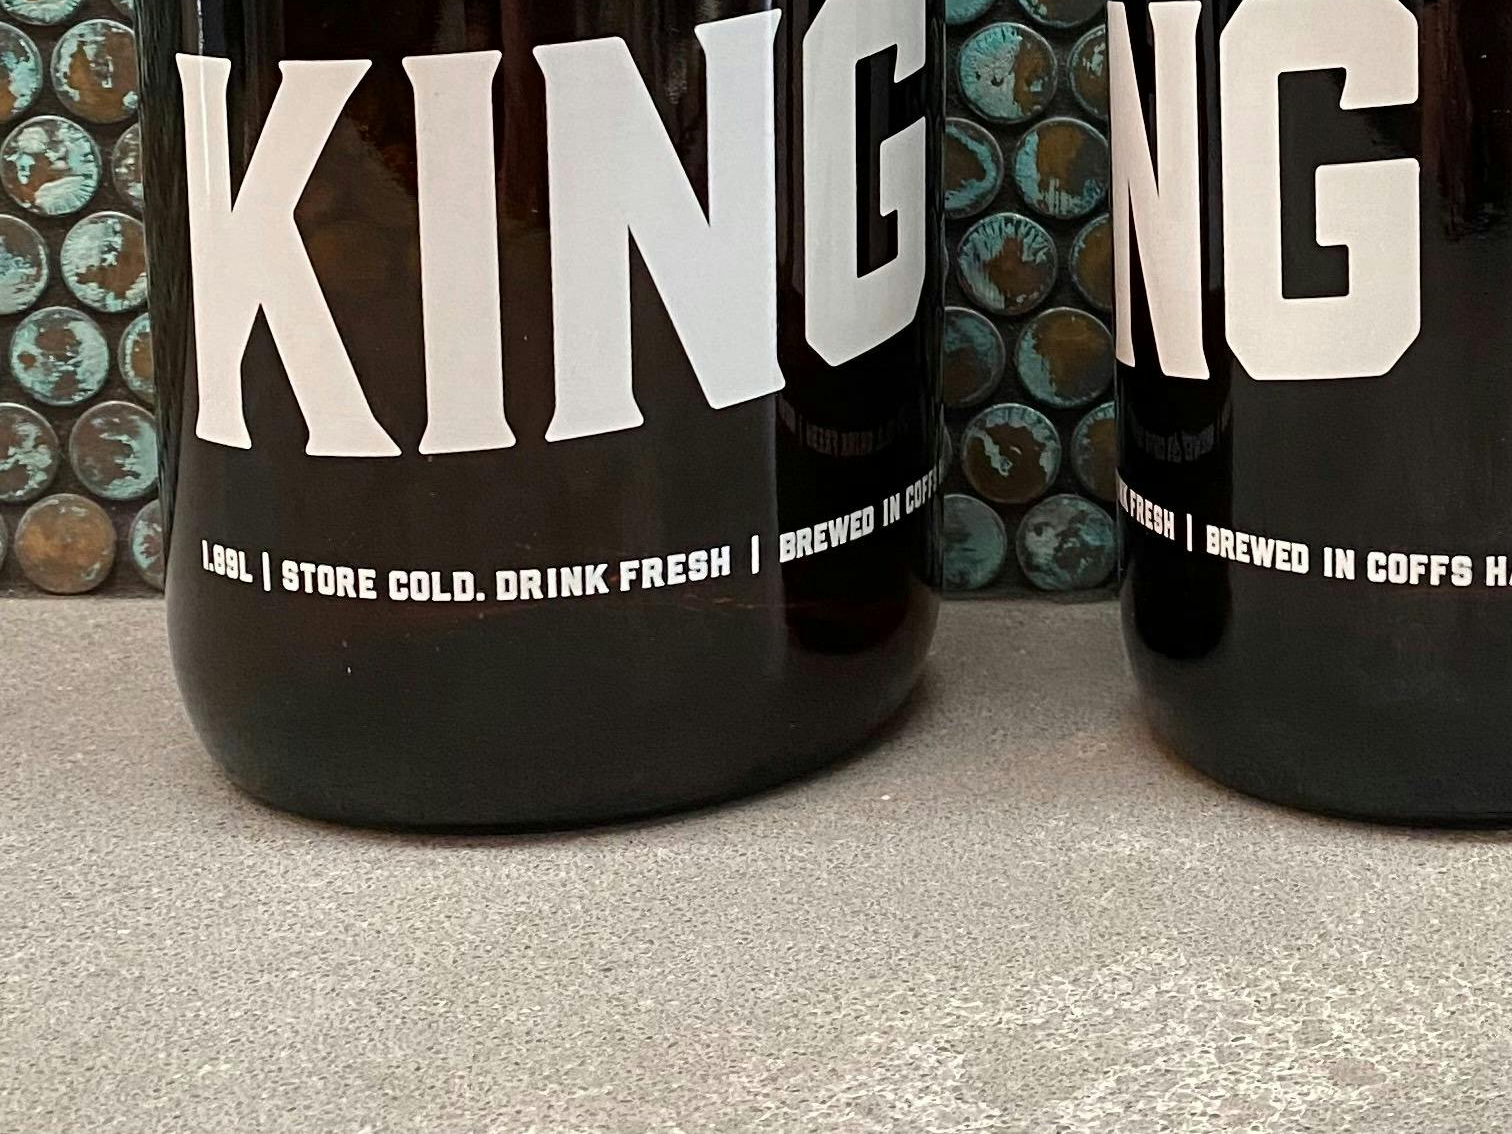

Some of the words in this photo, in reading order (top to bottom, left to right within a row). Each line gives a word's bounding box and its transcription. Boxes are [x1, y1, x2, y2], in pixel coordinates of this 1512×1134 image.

[281, 559, 378, 600] STORE
[388, 570, 486, 602] COLD.
[495, 563, 610, 601] DRINK
[619, 545, 731, 592] FRESH
[779, 505, 875, 564] BREWED
[882, 492, 901, 527] IN
[1129, 488, 1175, 541] FRESH
[1206, 524, 1310, 575] BREWED
[1323, 546, 1355, 580] IN
[1366, 551, 1473, 587] COFFS
